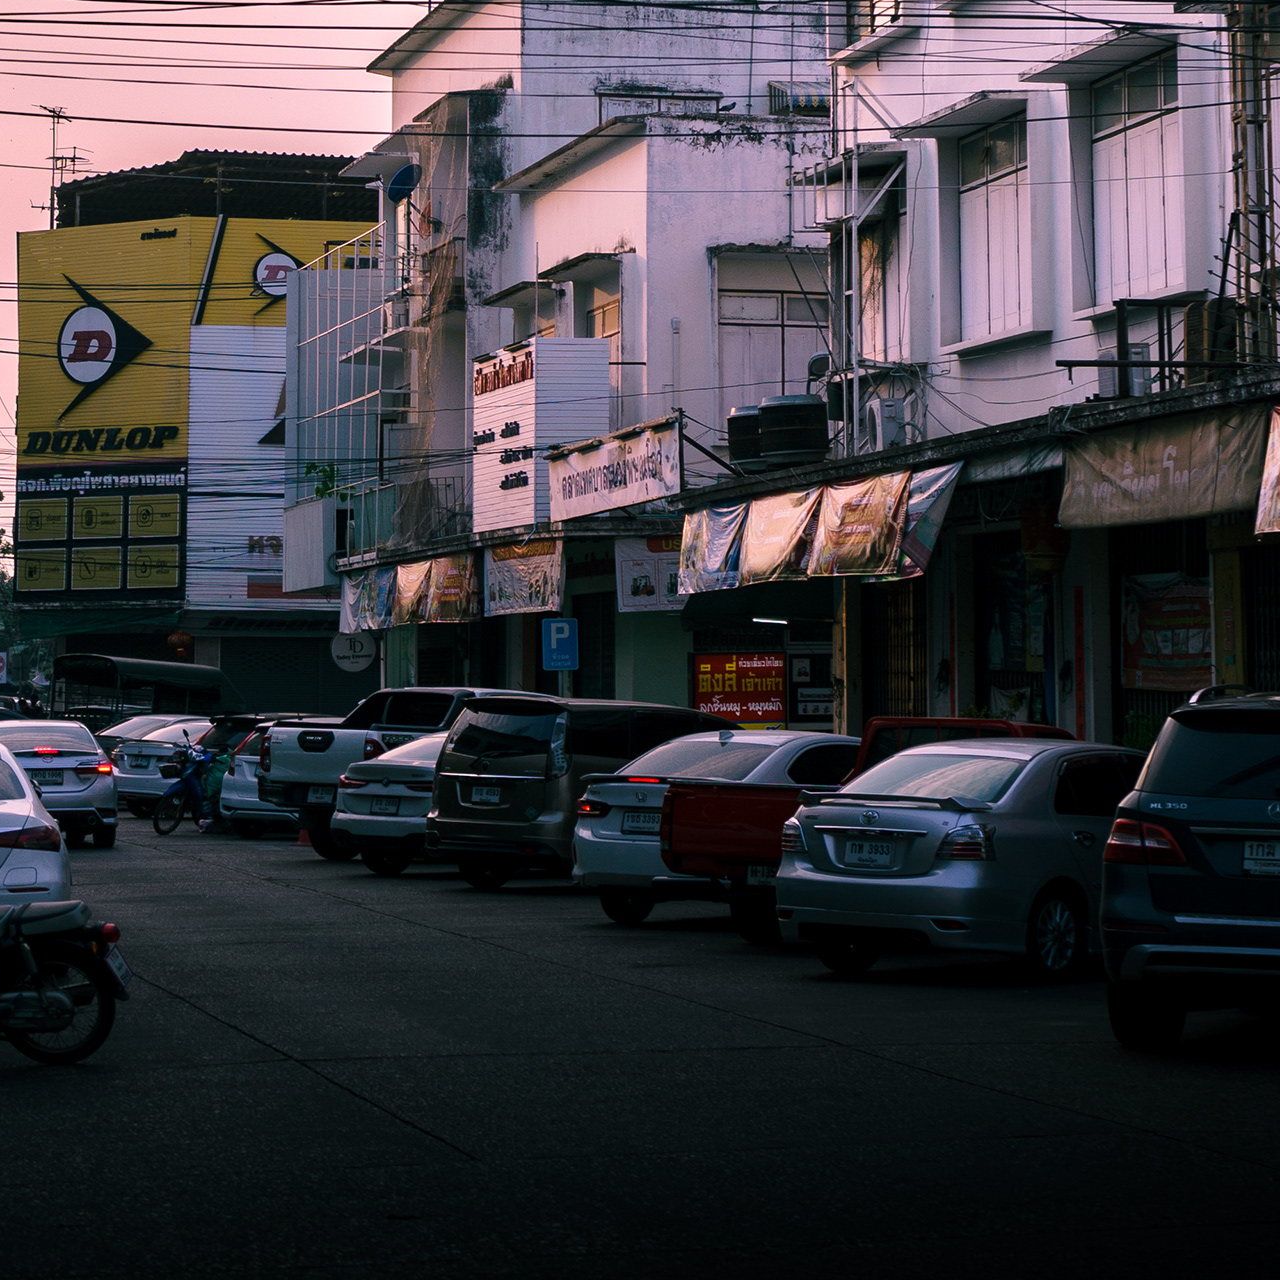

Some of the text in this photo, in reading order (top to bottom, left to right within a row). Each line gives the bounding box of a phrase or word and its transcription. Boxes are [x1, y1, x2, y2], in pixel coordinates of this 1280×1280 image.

[22, 425, 180, 455] DUNLOP
[550, 622, 570, 649] P
[741, 670, 783, 693] เจ้าเก่า
[699, 694, 741, 717] ลกชิ้นหมู
[867, 842, 891, 856] 3933
